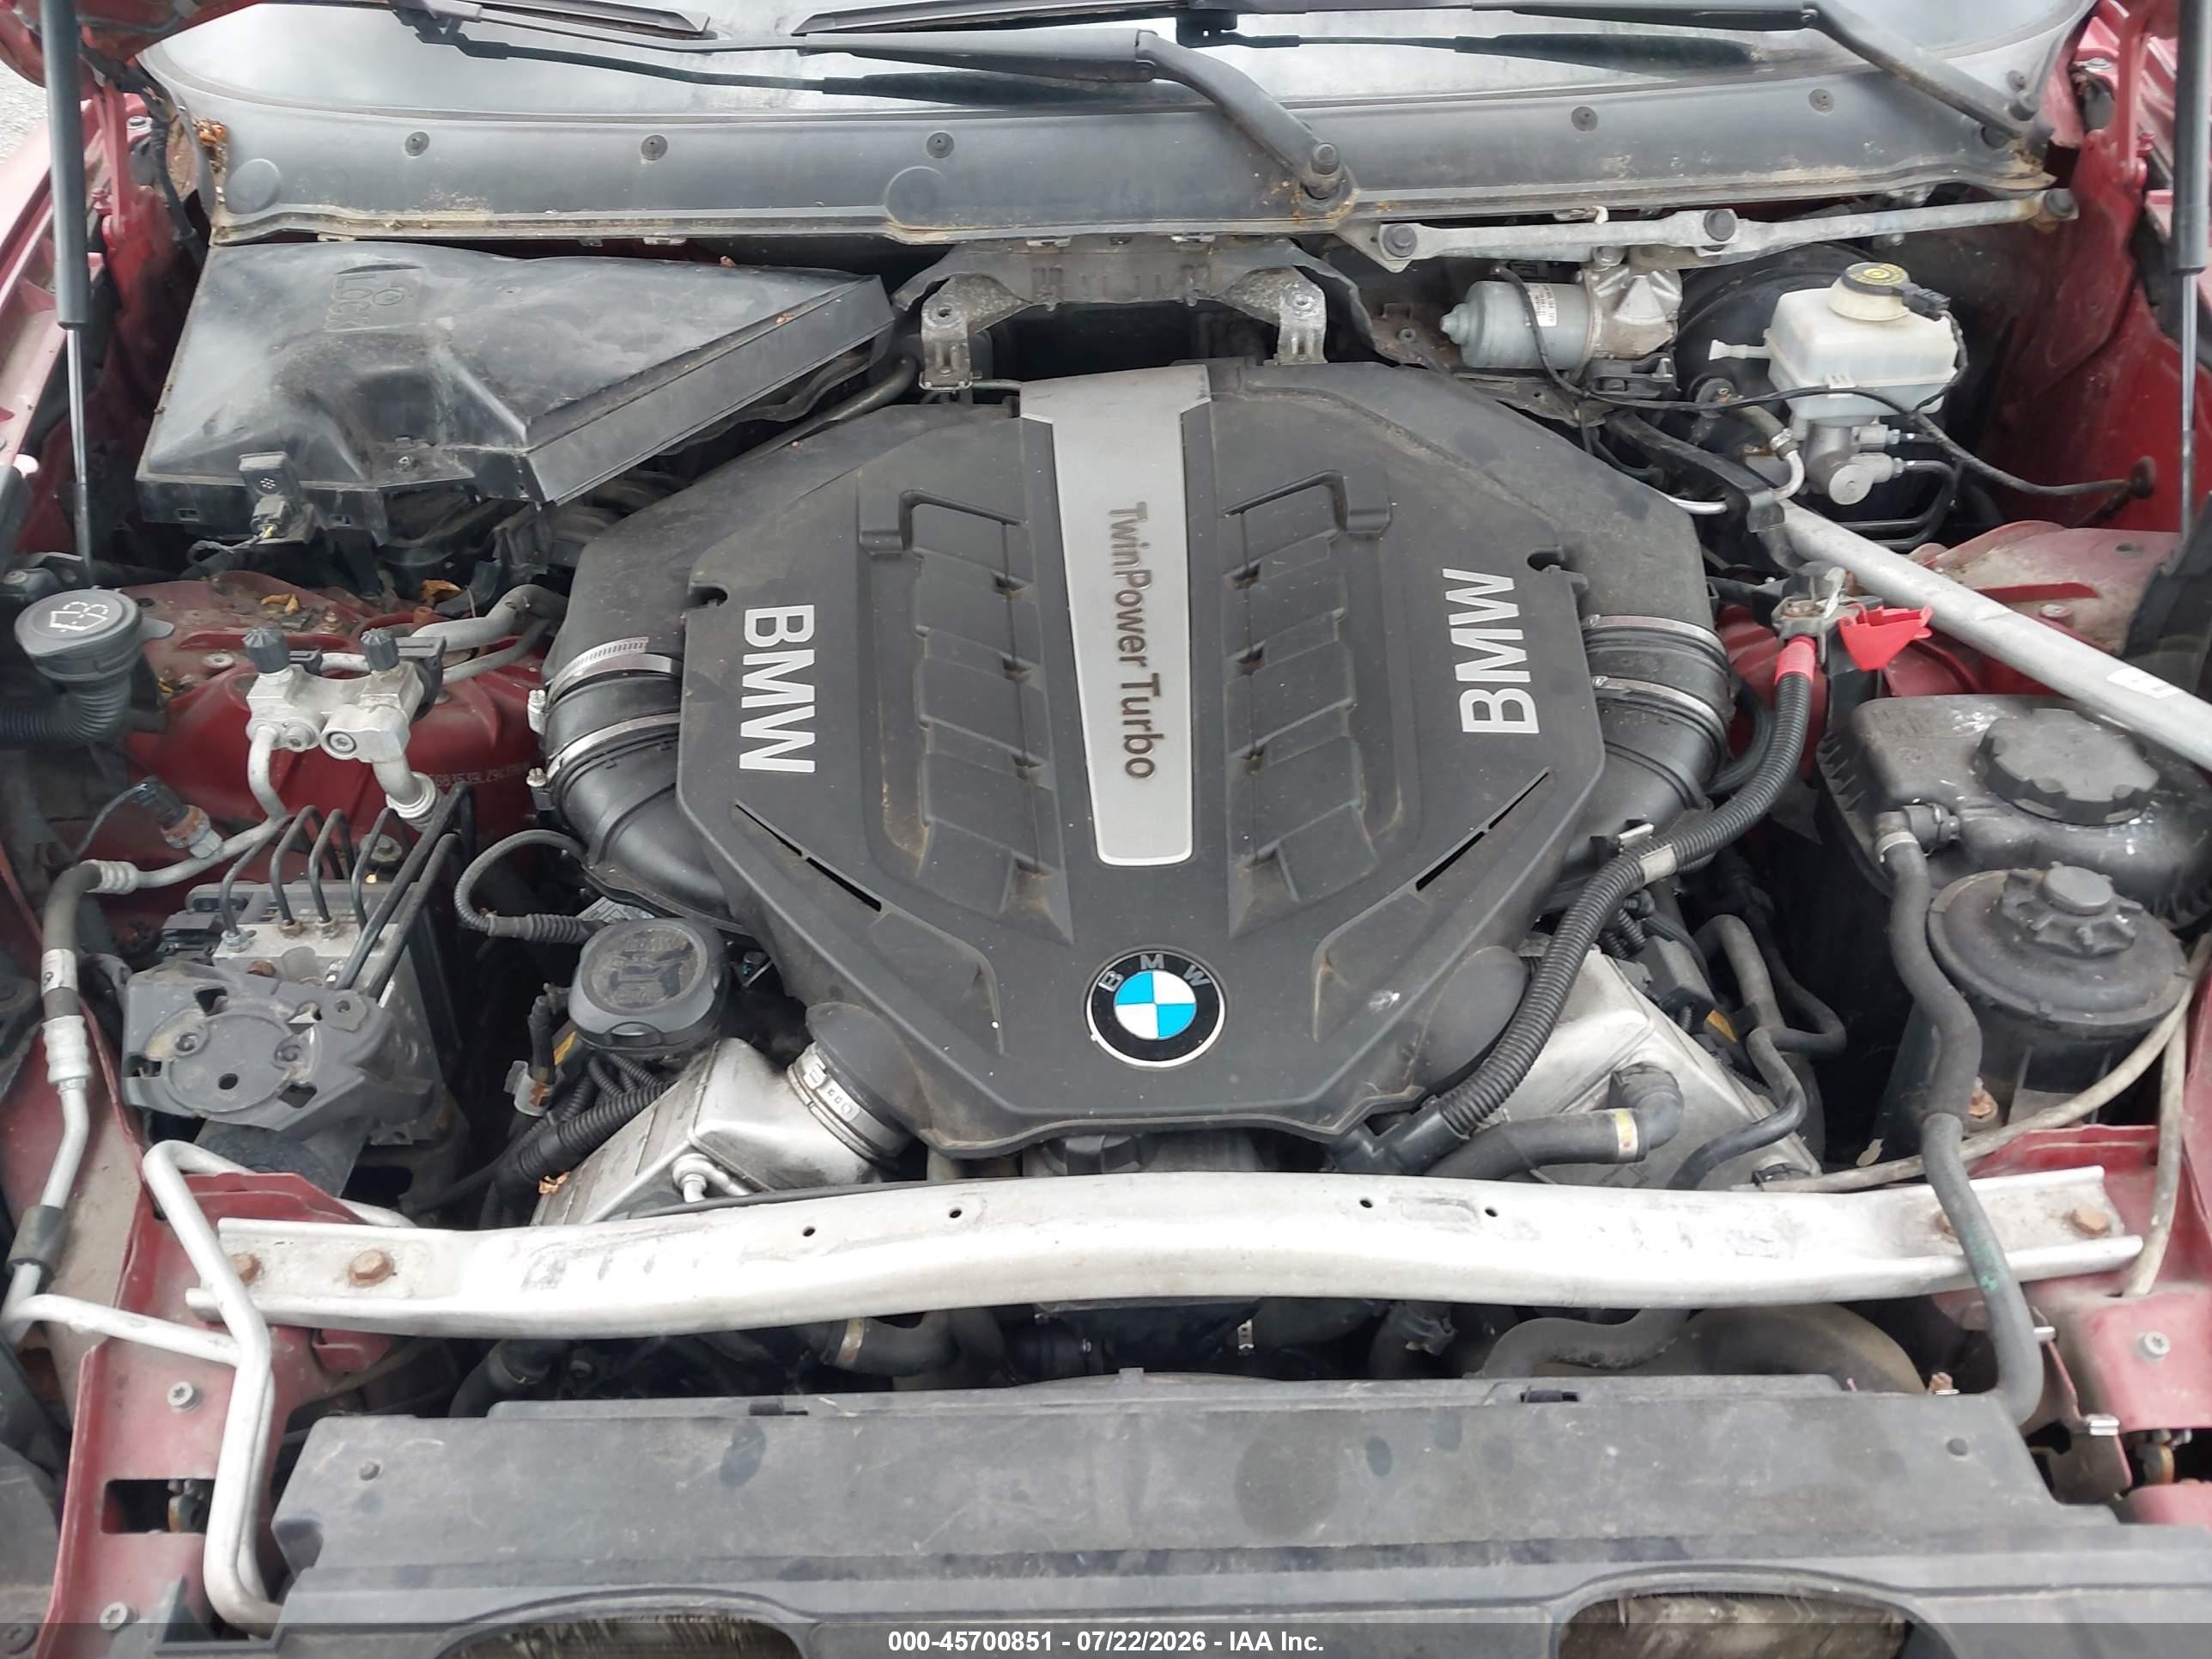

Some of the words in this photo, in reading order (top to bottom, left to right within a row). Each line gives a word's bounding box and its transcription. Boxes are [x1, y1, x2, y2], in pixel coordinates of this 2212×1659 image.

[1108, 501, 1152, 667] TwinPower
[1442, 568, 1540, 734] BMW
[738, 604, 816, 773] BMW
[1120, 672, 1165, 779] Turbo
[1098, 953, 1212, 993] BMW
